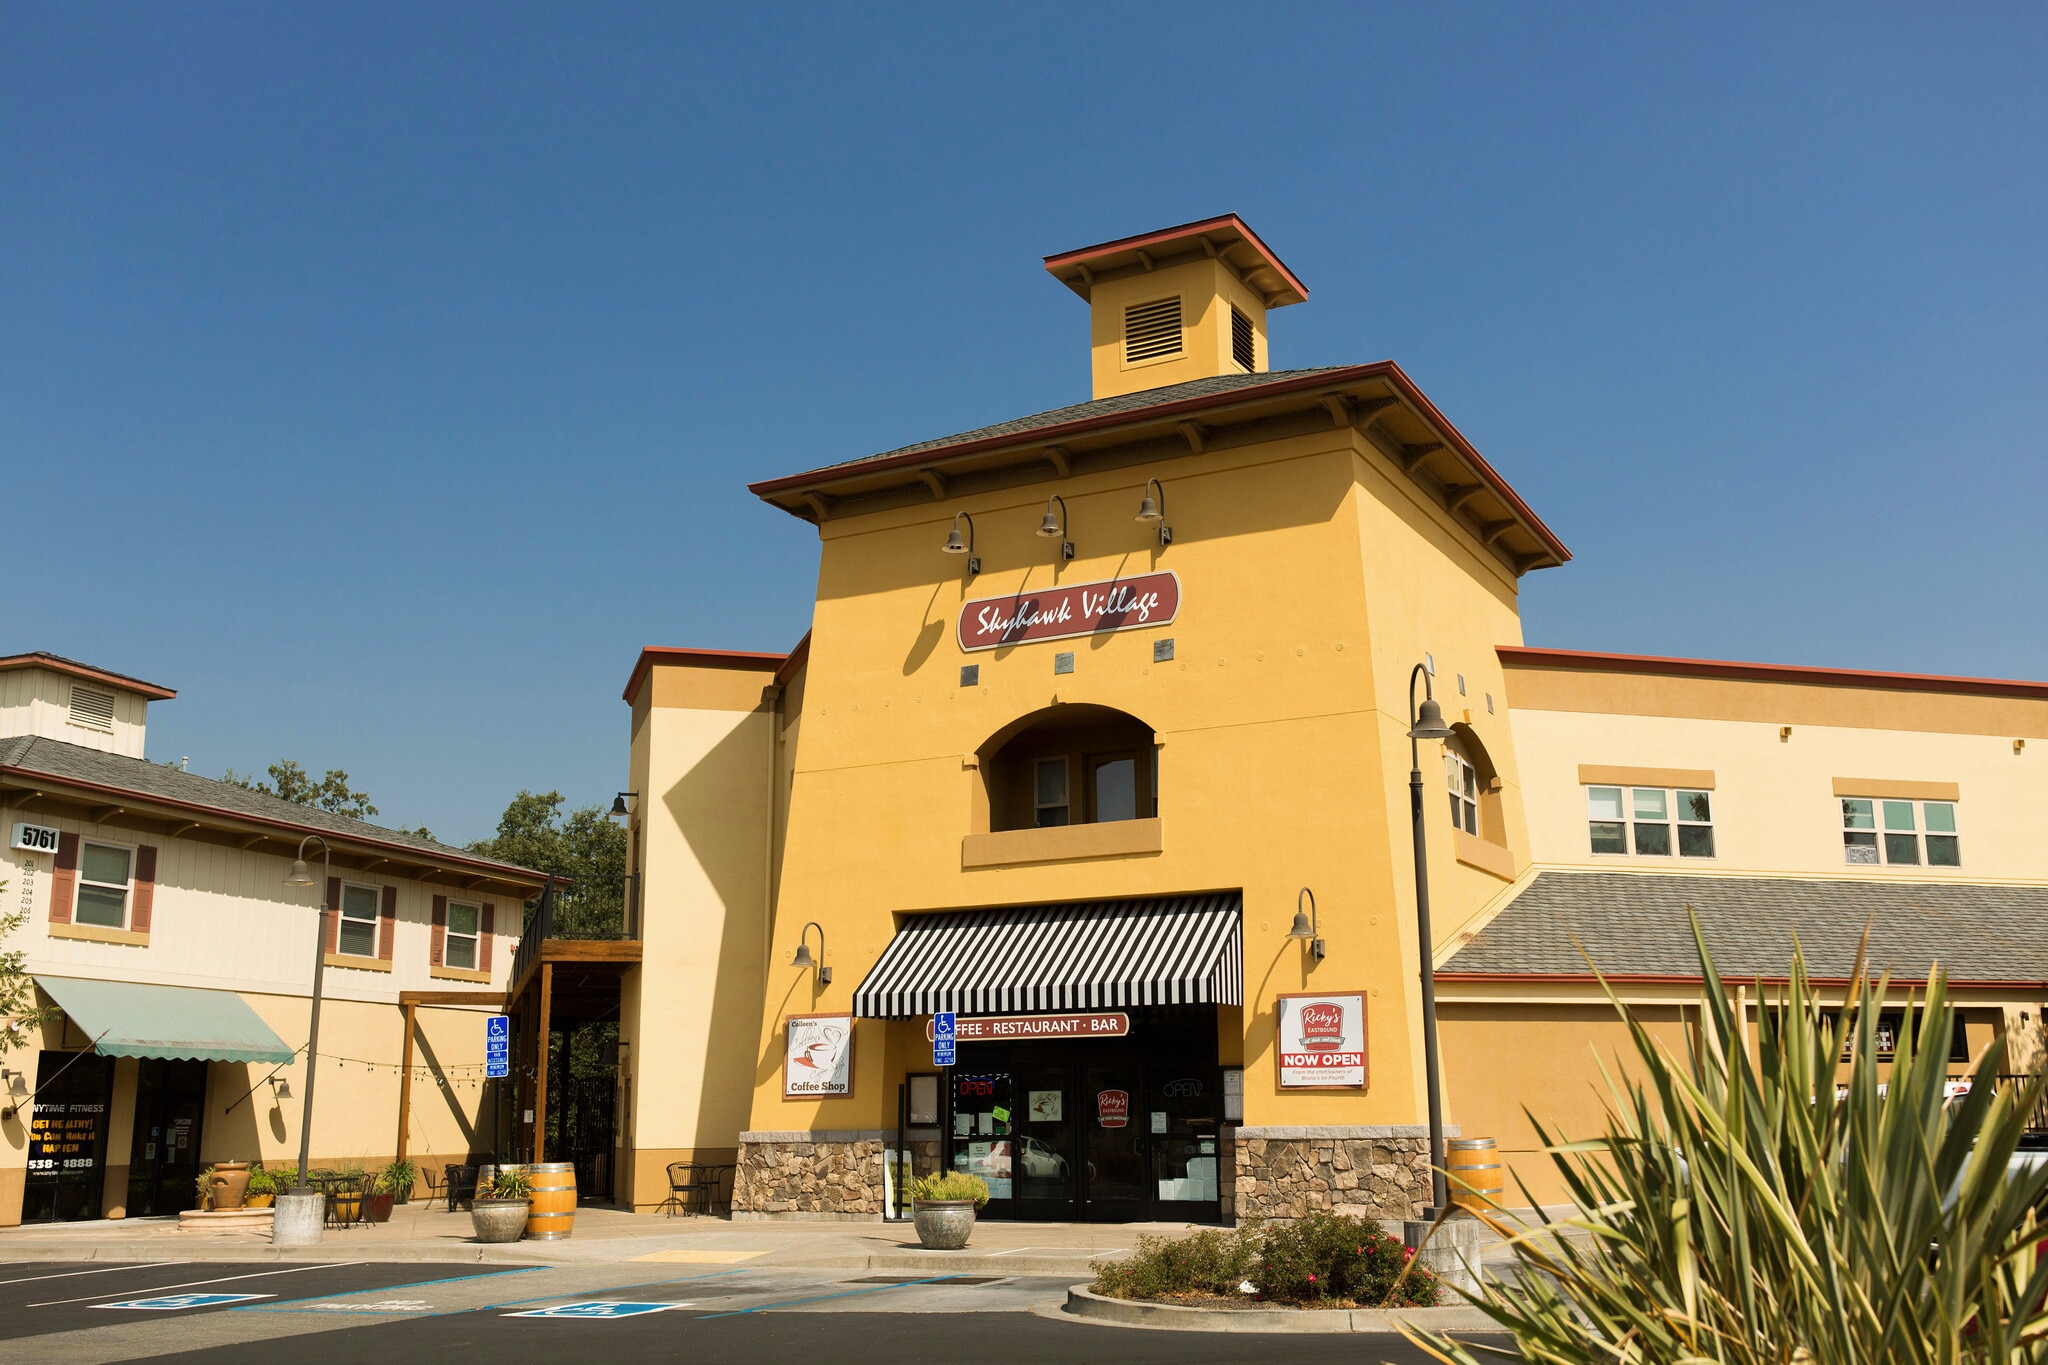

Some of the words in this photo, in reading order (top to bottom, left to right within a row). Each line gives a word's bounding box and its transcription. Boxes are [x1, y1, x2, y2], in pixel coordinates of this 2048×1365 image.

[976, 596, 1072, 641] Skyhawk
[1081, 585, 1159, 623] Village
[22, 826, 56, 850] 5761
[23, 868, 34, 877] 202
[1303, 1007, 1341, 1027] Ricky's
[791, 1020, 818, 1028] Colleen's
[955, 1023, 983, 1036] FFEE
[992, 1019, 1080, 1035] RESTAURANT
[1090, 1018, 1119, 1032] BAR
[488, 1035, 507, 1043] PARKING
[935, 1033, 954, 1041] PARKING
[938, 1041, 951, 1049] ONLY
[1284, 1054, 1319, 1067] NOW
[1322, 1053, 1361, 1066] OPEN
[790, 1081, 820, 1091] Coffee
[821, 1081, 846, 1093] Shop
[960, 1081, 993, 1096] OPEN
[1163, 1082, 1200, 1097] OPEN
[1100, 1093, 1126, 1109] Ricky's
[33, 1103, 65, 1113] NYTIME
[69, 1104, 105, 1113] FITNESS
[32, 1119, 50, 1129] GET
